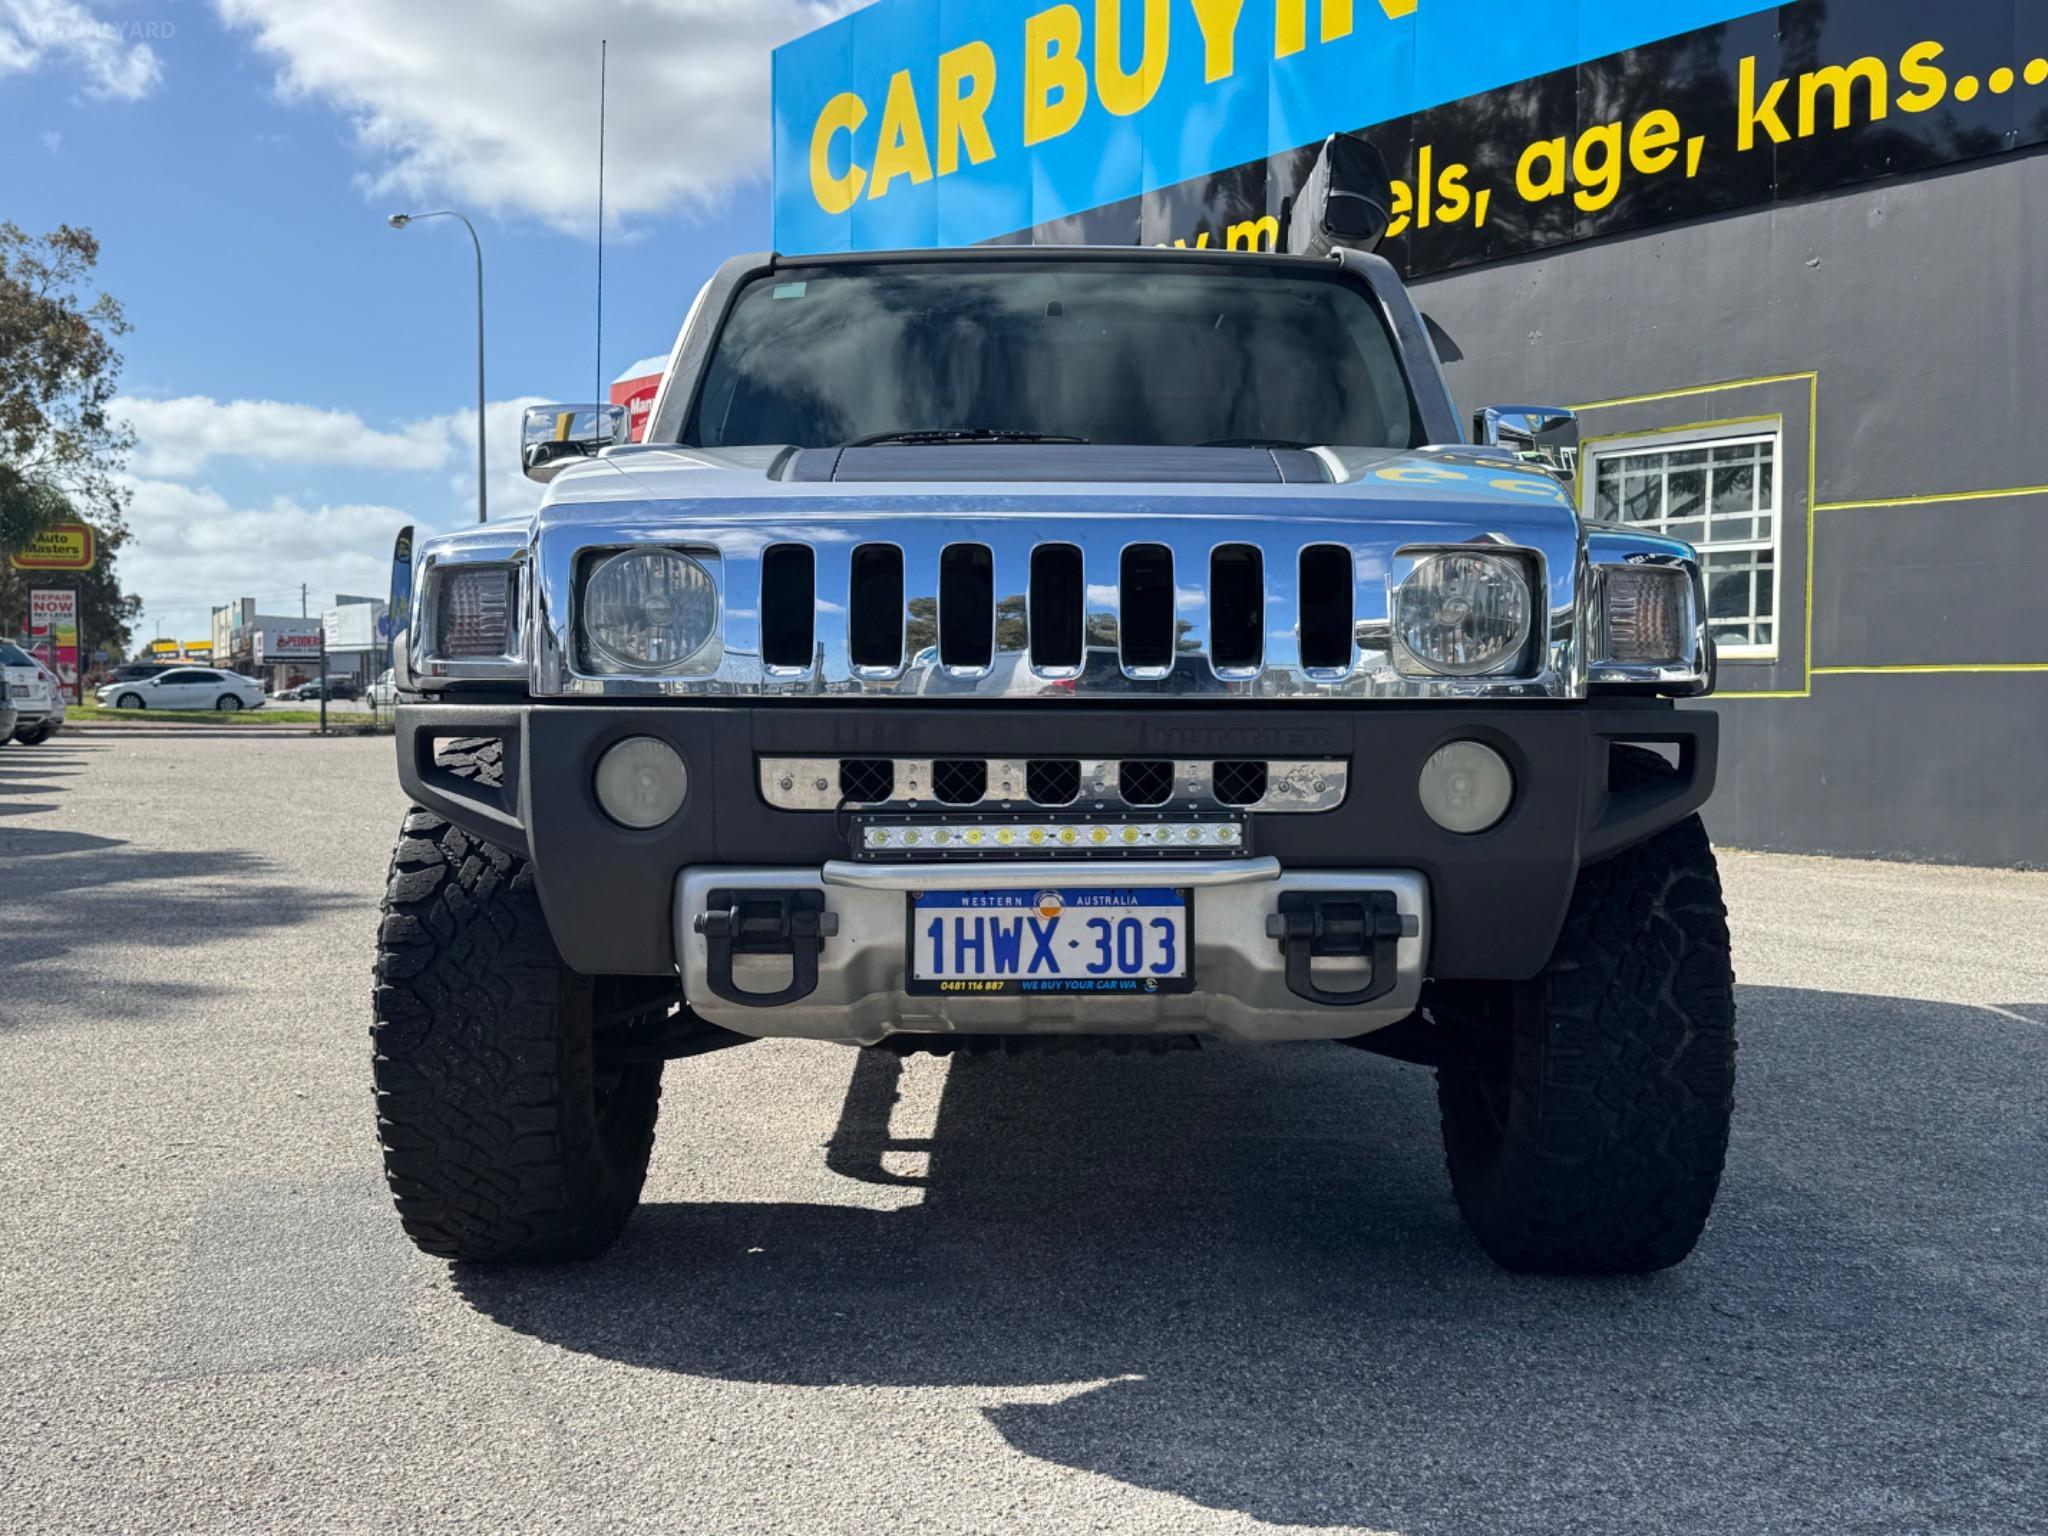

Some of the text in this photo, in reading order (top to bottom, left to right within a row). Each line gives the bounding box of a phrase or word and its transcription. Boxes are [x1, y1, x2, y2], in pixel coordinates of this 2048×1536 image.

[810, 0, 1418, 214] CAR BUY
[1515, 108, 1707, 212] age,
[1737, 40, 2048, 152] kms...
[36, 533, 69, 543] Auto
[24, 544, 80, 554] Masters
[33, 602, 73, 611] NOW
[287, 635, 320, 648] PEDDER
[1152, 727, 1332, 746] HUMMER
[961, 896, 1139, 906] WESTERN AUSTRALIA
[940, 981, 1004, 991] 0481 116 887
[1022, 981, 1137, 990] WE BUY YOUR CAR WA
